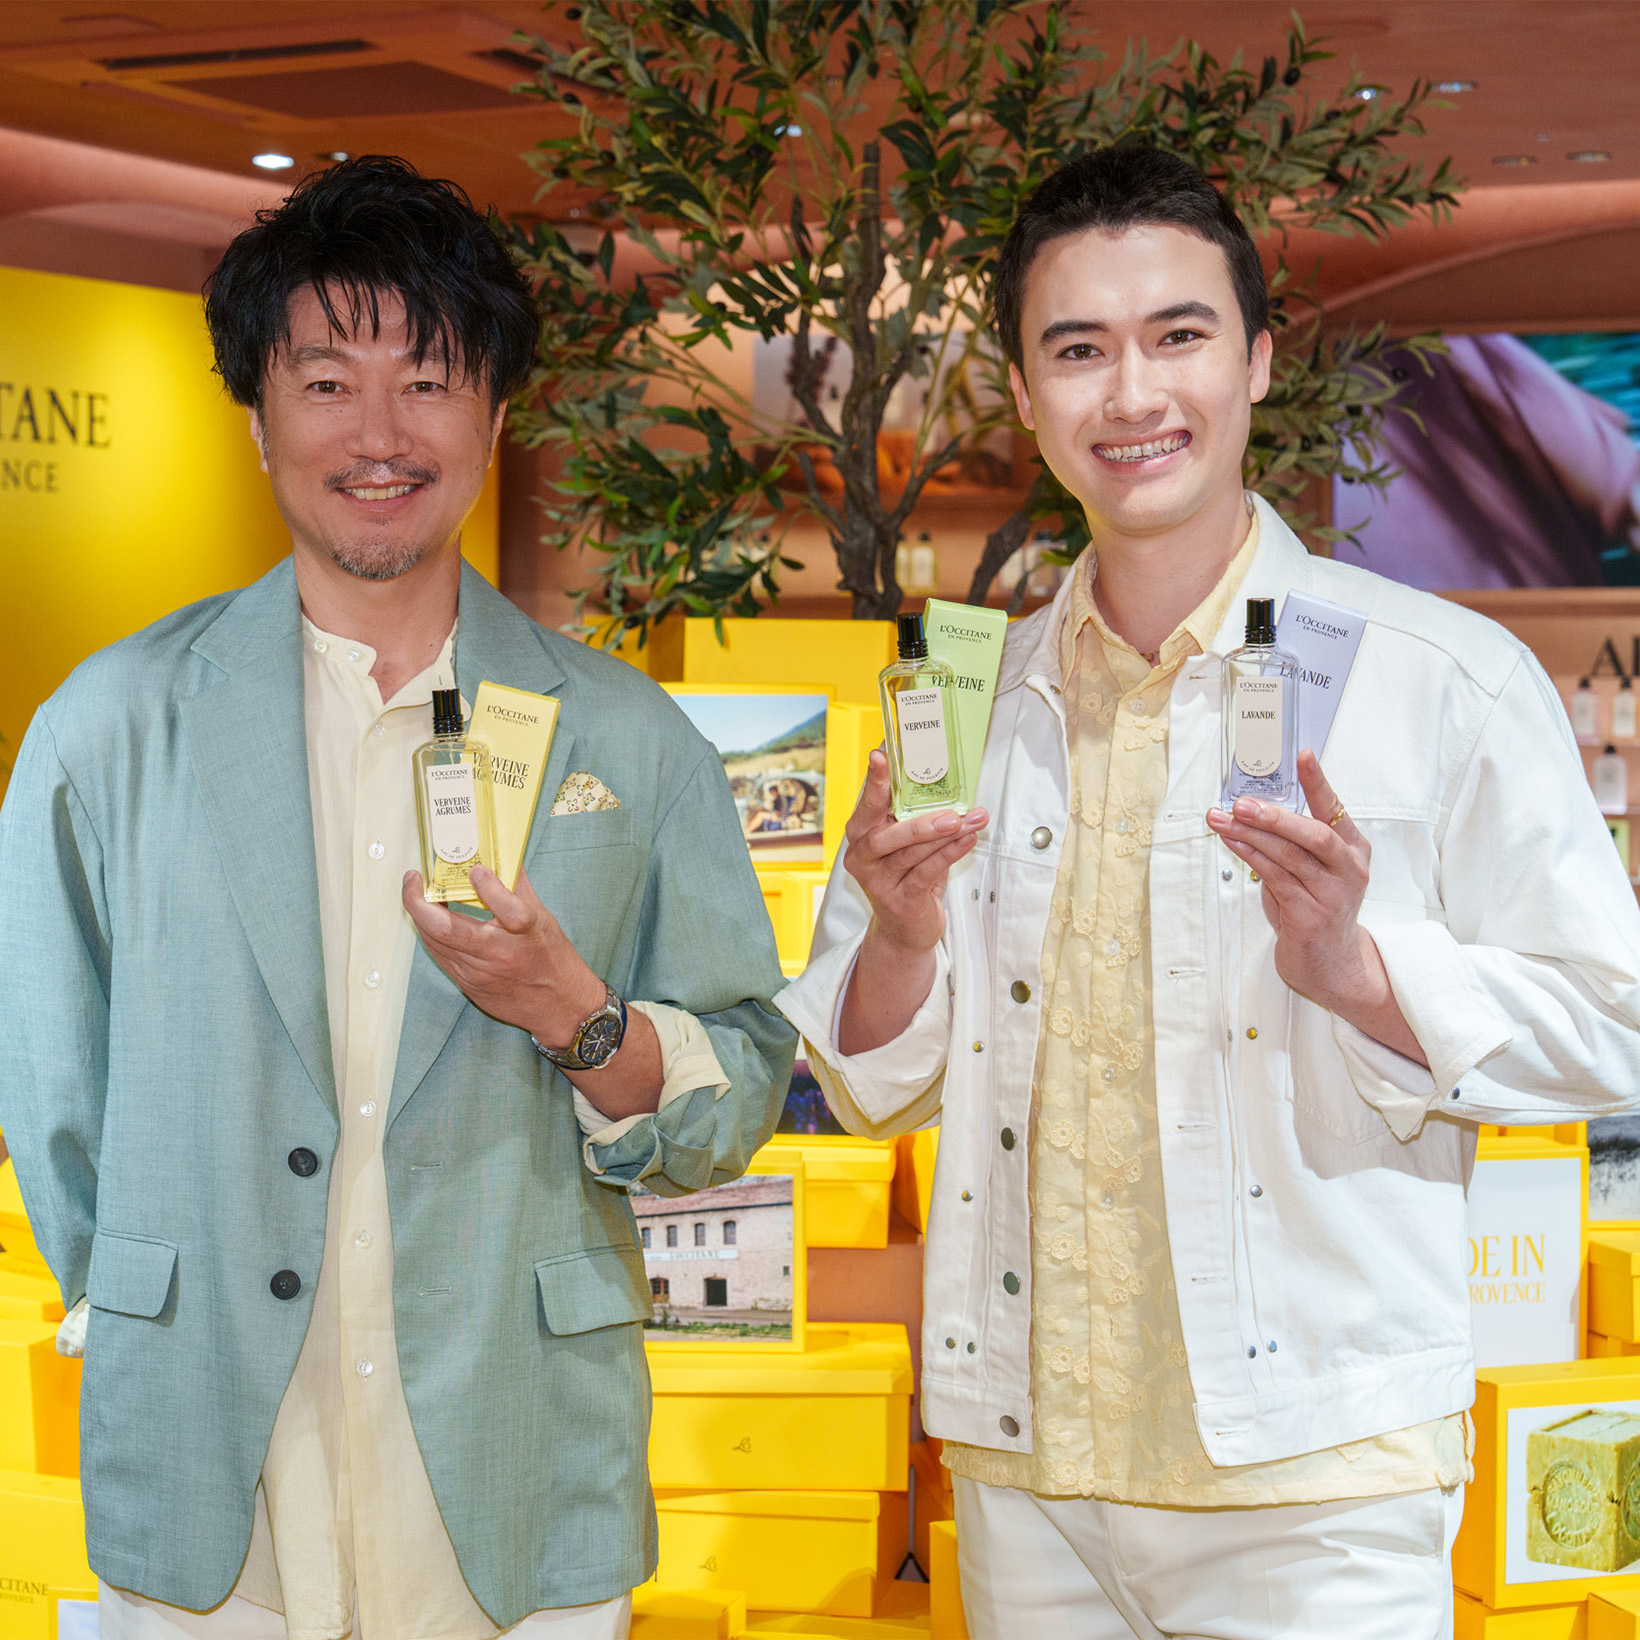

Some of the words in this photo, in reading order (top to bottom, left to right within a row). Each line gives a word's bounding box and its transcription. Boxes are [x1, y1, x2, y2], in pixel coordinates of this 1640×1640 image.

[1296, 614, 1349, 638] L'OCCITANE
[940, 625, 992, 640] L'OCCITANE
[1310, 628, 1338, 640] PROVENCE
[956, 635, 982, 643] PROVENCE
[901, 694, 937, 702] L'OCCITANE
[487, 704, 540, 724] L'OCCITANE
[1241, 710, 1276, 719] LAVANDE
[904, 720, 941, 731] VERVEINE
[431, 769, 468, 777] L'OCCITANE
[434, 796, 471, 807] VERVEINE
[436, 805, 472, 816] AGRUMES
[1511, 1233, 1546, 1277] IN
